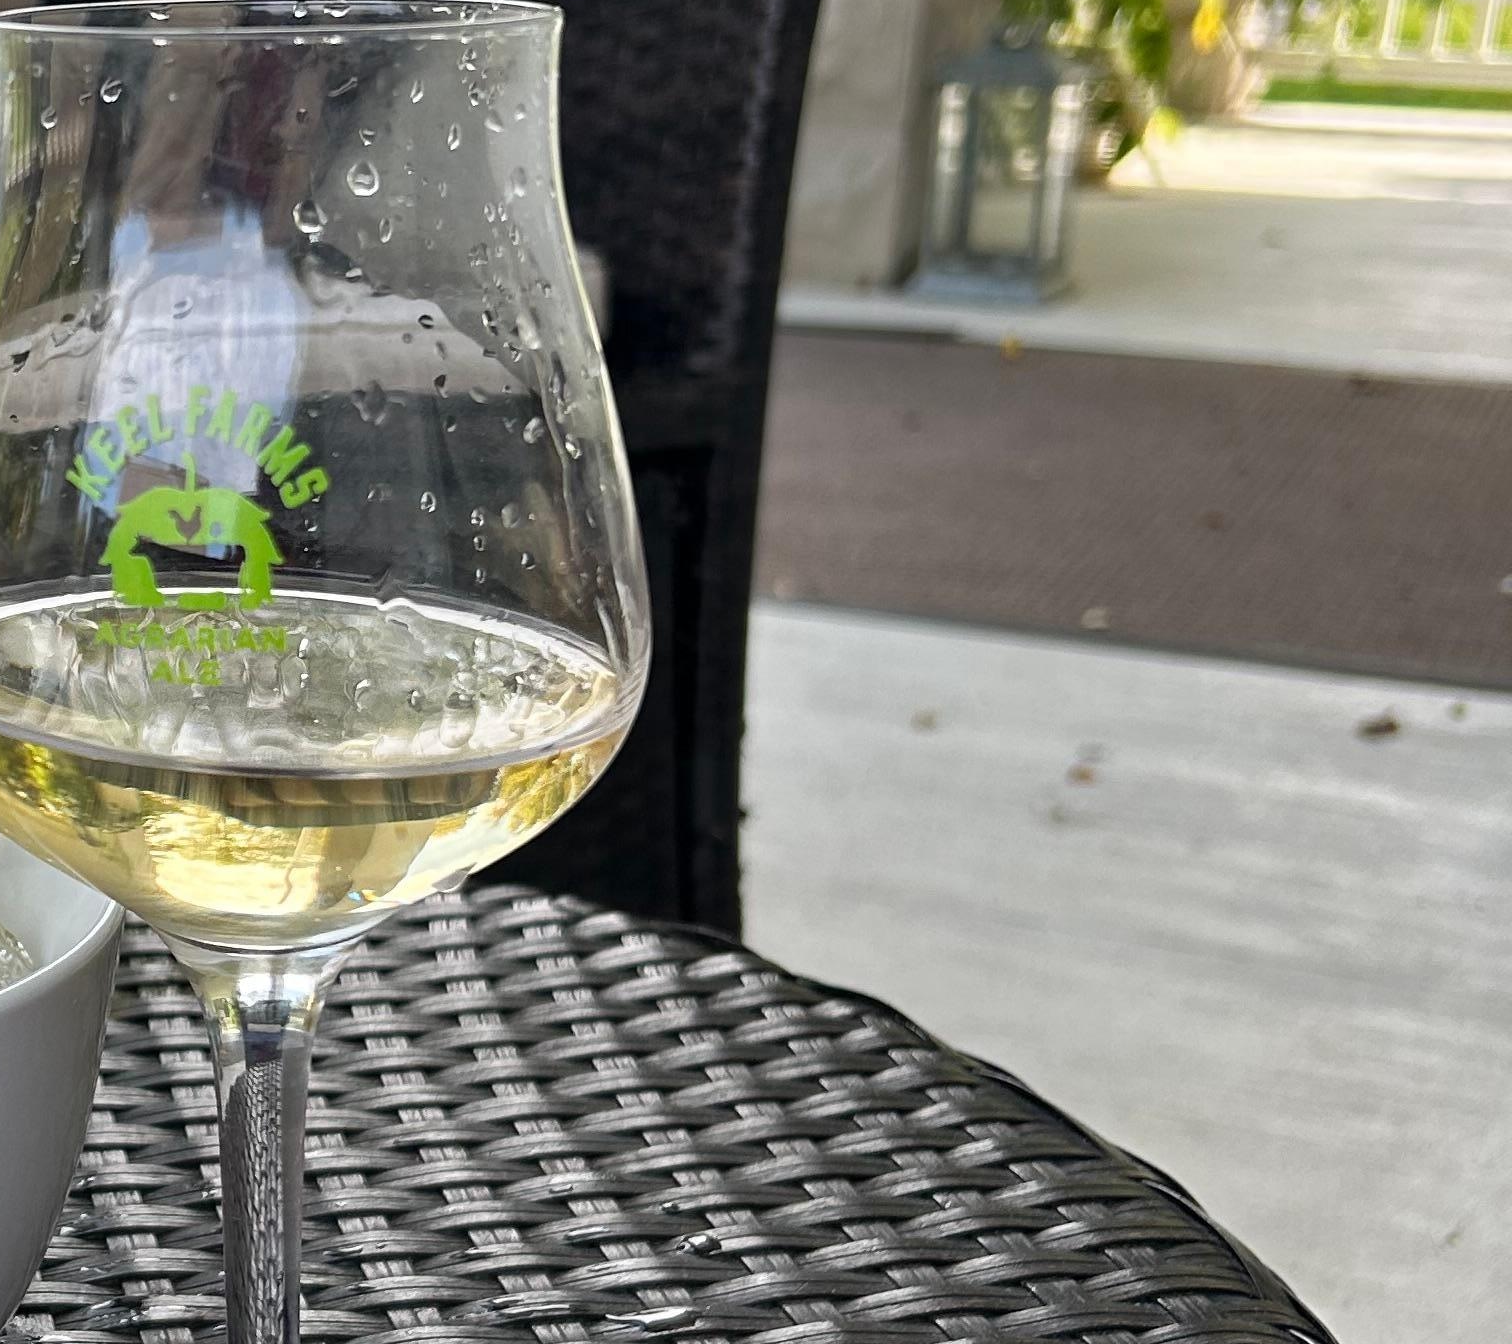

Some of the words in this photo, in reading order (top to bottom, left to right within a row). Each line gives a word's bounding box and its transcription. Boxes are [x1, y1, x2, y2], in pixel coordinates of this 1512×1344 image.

[65, 394, 175, 502] KEEL
[185, 384, 329, 509] FARMS
[94, 621, 288, 652] AGRARIAN
[150, 660, 223, 687] ALE
